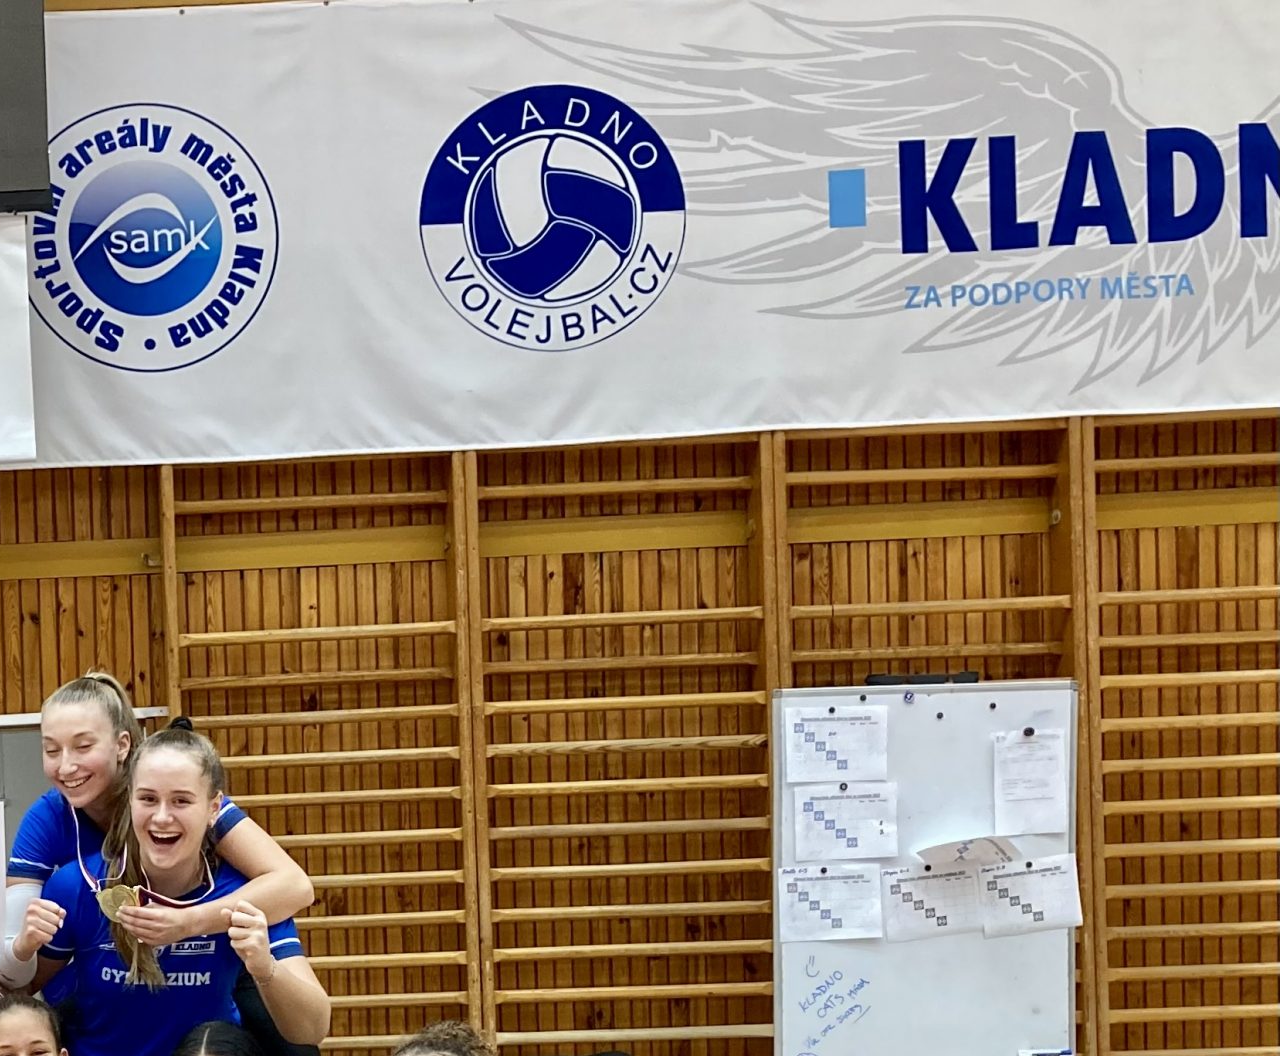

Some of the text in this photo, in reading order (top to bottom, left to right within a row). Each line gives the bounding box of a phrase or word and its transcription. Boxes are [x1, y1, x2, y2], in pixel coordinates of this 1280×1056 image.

[58, 116, 171, 179] areály
[446, 97, 658, 176] KLADNO
[179, 131, 259, 234] města
[109, 219, 210, 255] samk
[168, 243, 264, 349] Kladna
[904, 271, 1195, 309] ZA PODPORY MĚSTA
